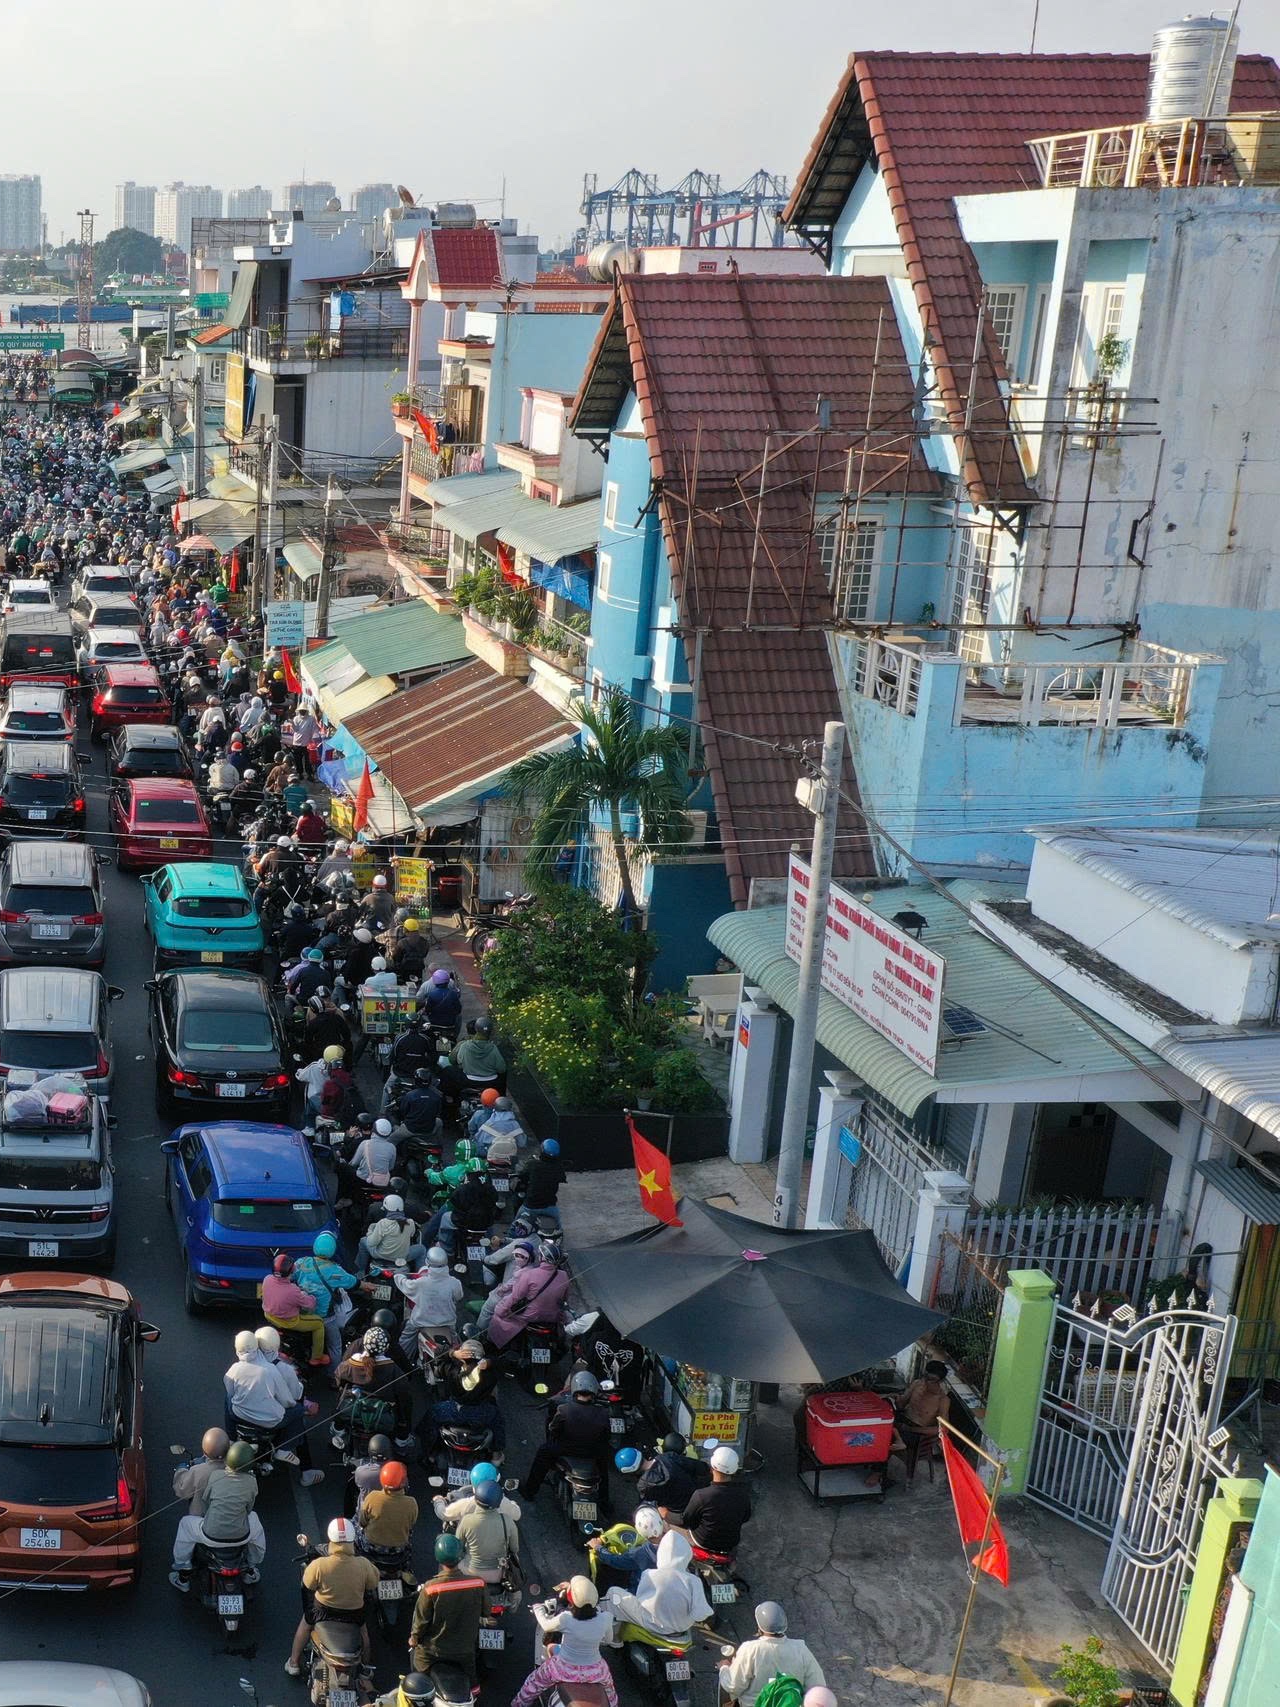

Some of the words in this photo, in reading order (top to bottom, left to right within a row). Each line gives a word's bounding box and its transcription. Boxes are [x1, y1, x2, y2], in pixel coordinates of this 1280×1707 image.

[7, 340, 19, 348] QUÝ
[23, 340, 44, 348] KHÁCH
[32, 1528, 49, 1538] 60K
[25, 1537, 57, 1547] 254.89
